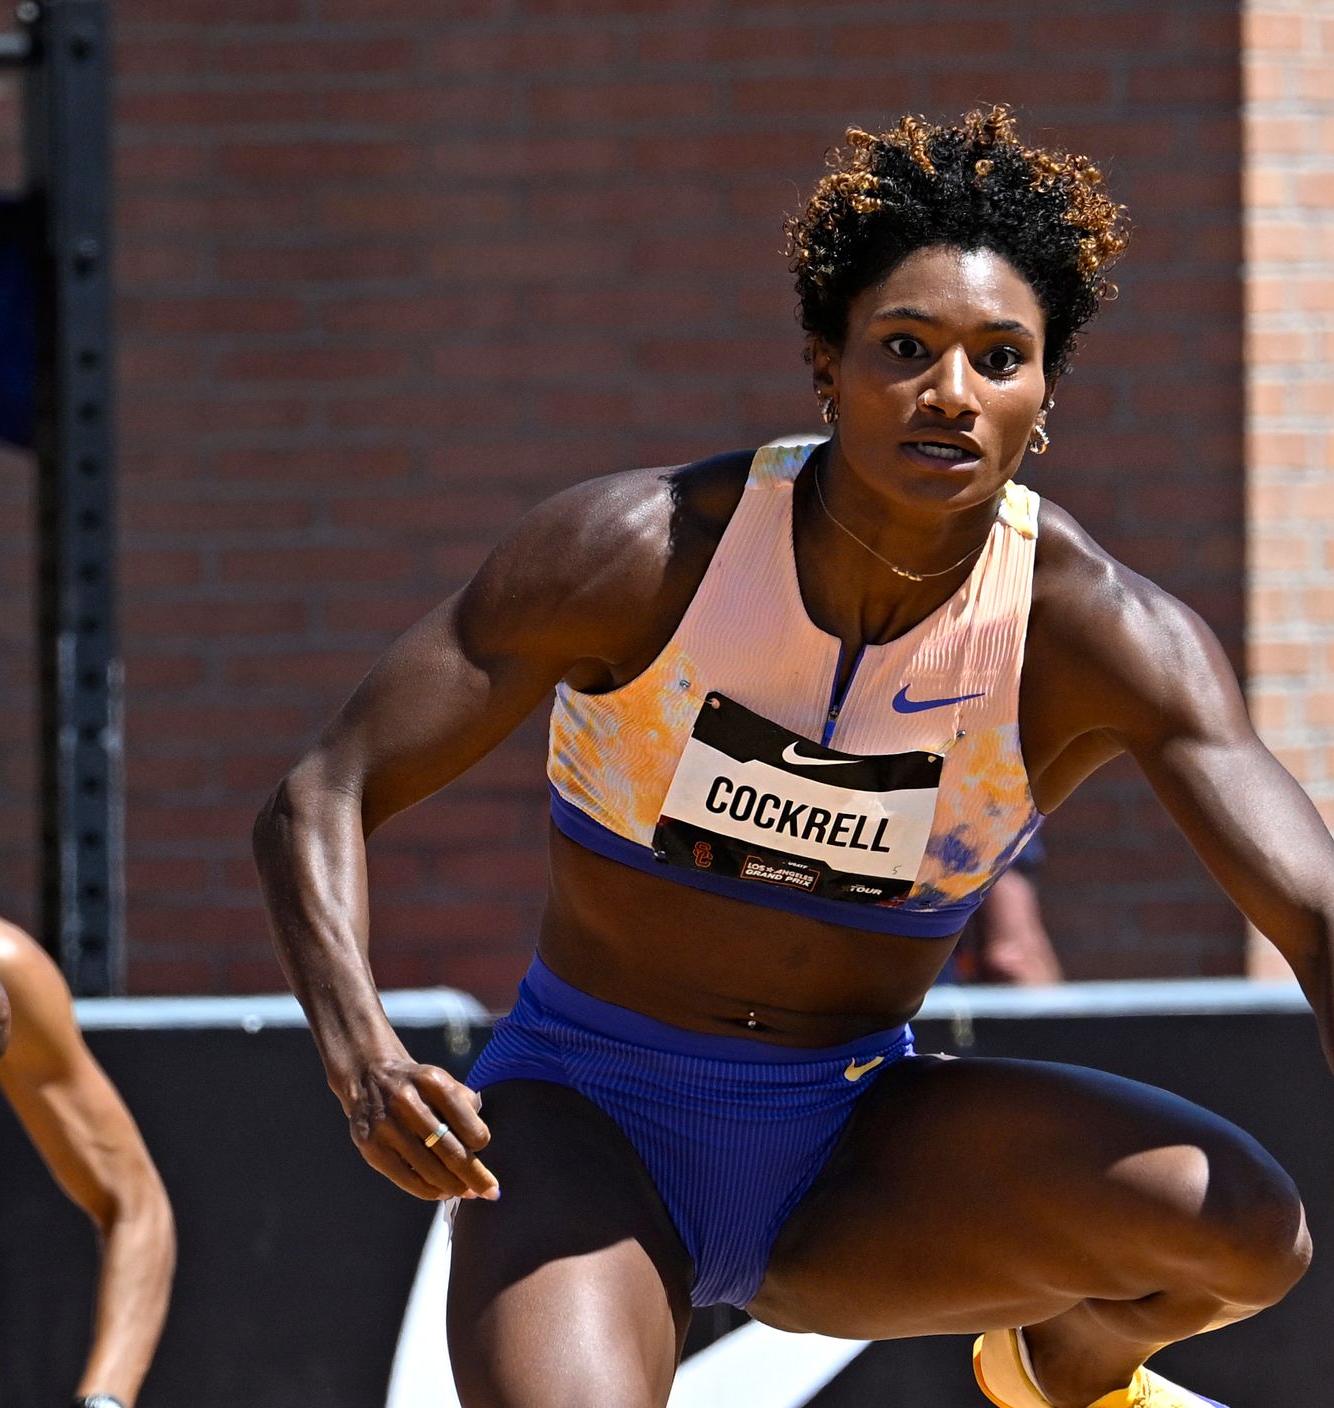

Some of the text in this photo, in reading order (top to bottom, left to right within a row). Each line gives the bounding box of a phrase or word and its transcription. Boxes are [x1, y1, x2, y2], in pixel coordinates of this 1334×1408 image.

[705, 776, 891, 853] COCKRELL
[745, 869, 811, 887] GRAND PRIX
[747, 862, 814, 882] LOS ANGELES
[850, 885, 883, 896] TOUR
